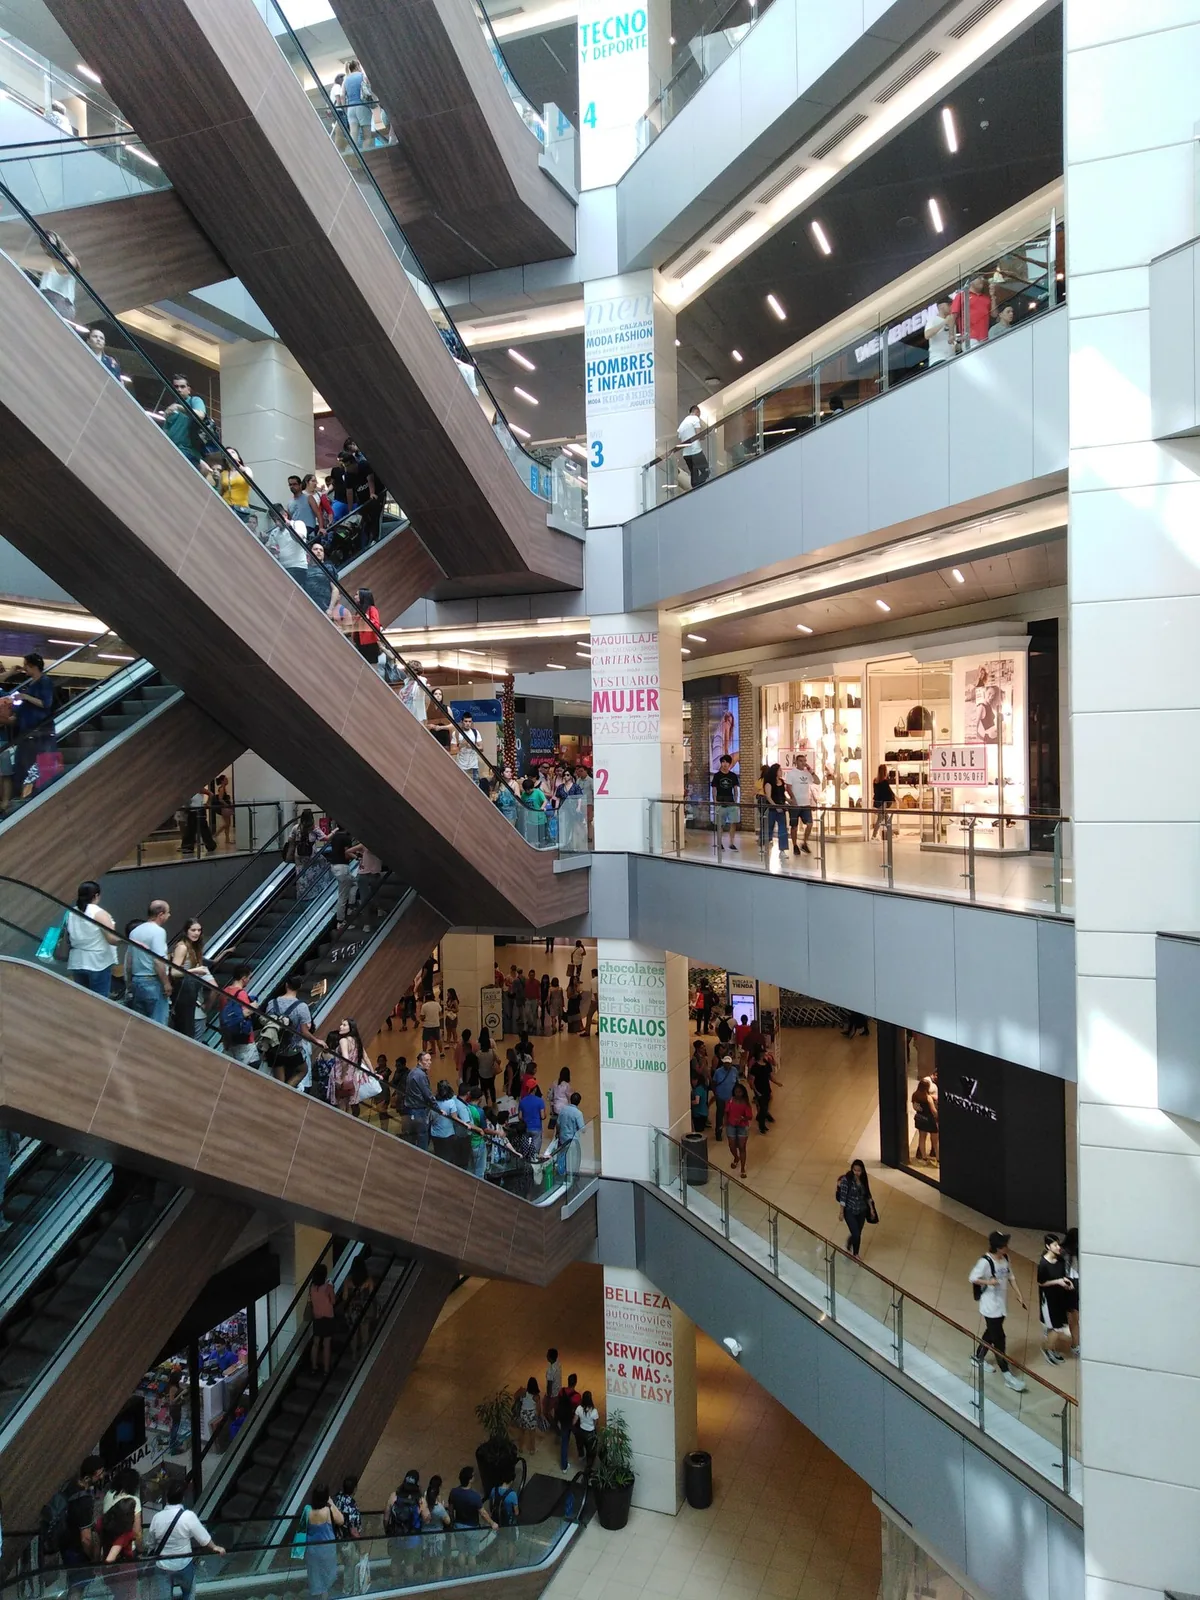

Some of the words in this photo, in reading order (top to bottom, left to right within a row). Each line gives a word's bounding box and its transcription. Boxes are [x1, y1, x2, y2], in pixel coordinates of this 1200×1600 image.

[580, 8, 647, 47] TECNO
[581, 49, 588, 63] Y
[593, 33, 648, 60] DEPORTE
[583, 101, 597, 129] 4
[620, 320, 653, 331] CALZADO
[586, 334, 613, 349] MODA
[615, 328, 653, 343] FASHION
[587, 352, 654, 378] HOMBRES
[587, 379, 593, 393] E
[598, 370, 654, 391] INFANTIL
[590, 440, 604, 468] 3
[591, 633, 658, 646] MAQUILLAJE
[591, 654, 643, 666] CARTERAS
[593, 674, 659, 688] VESTUARIO
[592, 689, 659, 713] MUJER
[530, 728, 553, 738] PRONTO
[593, 720, 659, 735] FASHION
[941, 750, 975, 767] SALE
[595, 768, 609, 795] 2
[933, 772, 941, 781] UP
[942, 772, 950, 781] TO
[954, 772, 970, 781] 50%
[972, 772, 984, 781] OFF
[599, 961, 665, 975] chocolates
[599, 973, 665, 989] REGALOS
[599, 1002, 631, 1013] GIFTS
[633, 1003, 665, 1016] GIFTS
[623, 996, 640, 1004] books
[599, 1016, 666, 1037] REGALOS
[600, 1039, 618, 1047] GIFTS
[623, 1041, 642, 1050] GIFTS
[647, 1043, 666, 1051] GIFTS
[600, 1056, 633, 1069] JUMBO
[634, 1059, 666, 1072] JUMBO
[605, 1091, 614, 1119] 1
[605, 1286, 672, 1310] BELLEZA
[605, 1309, 672, 1329] automóviles
[606, 1341, 673, 1367] SERVICIOS
[617, 1363, 627, 1378] &
[631, 1364, 661, 1384] MÁS
[606, 1376, 637, 1397] EASY
[640, 1384, 673, 1404] EASY
